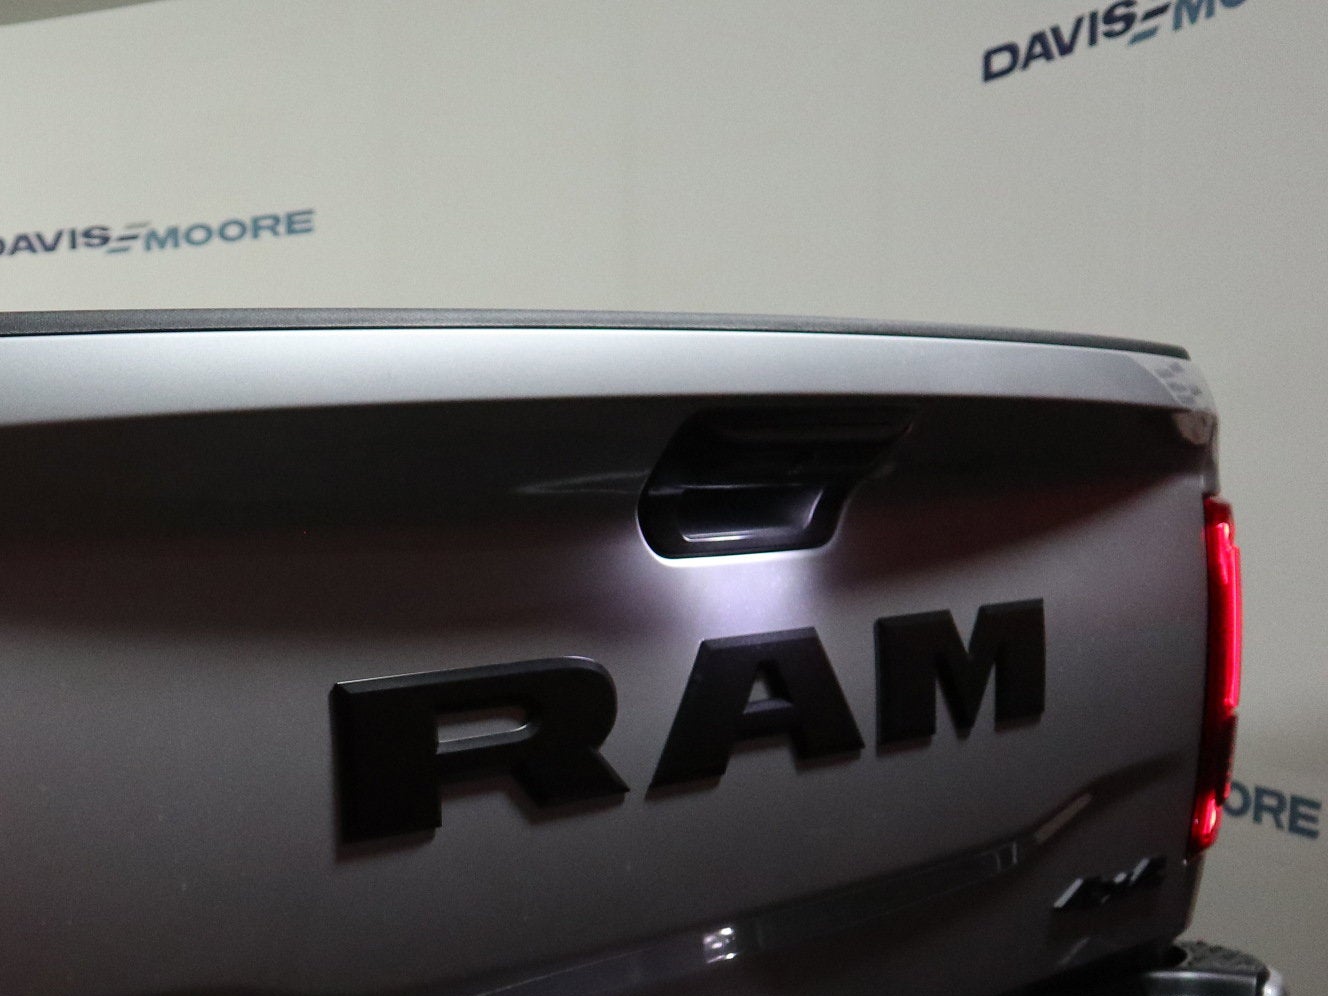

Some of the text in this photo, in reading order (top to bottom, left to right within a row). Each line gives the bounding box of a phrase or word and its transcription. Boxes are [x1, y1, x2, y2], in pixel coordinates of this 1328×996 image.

[982, 0, 1139, 82] DAVIS
[143, 208, 316, 251] MOORE
[329, 597, 1046, 844] RAM
